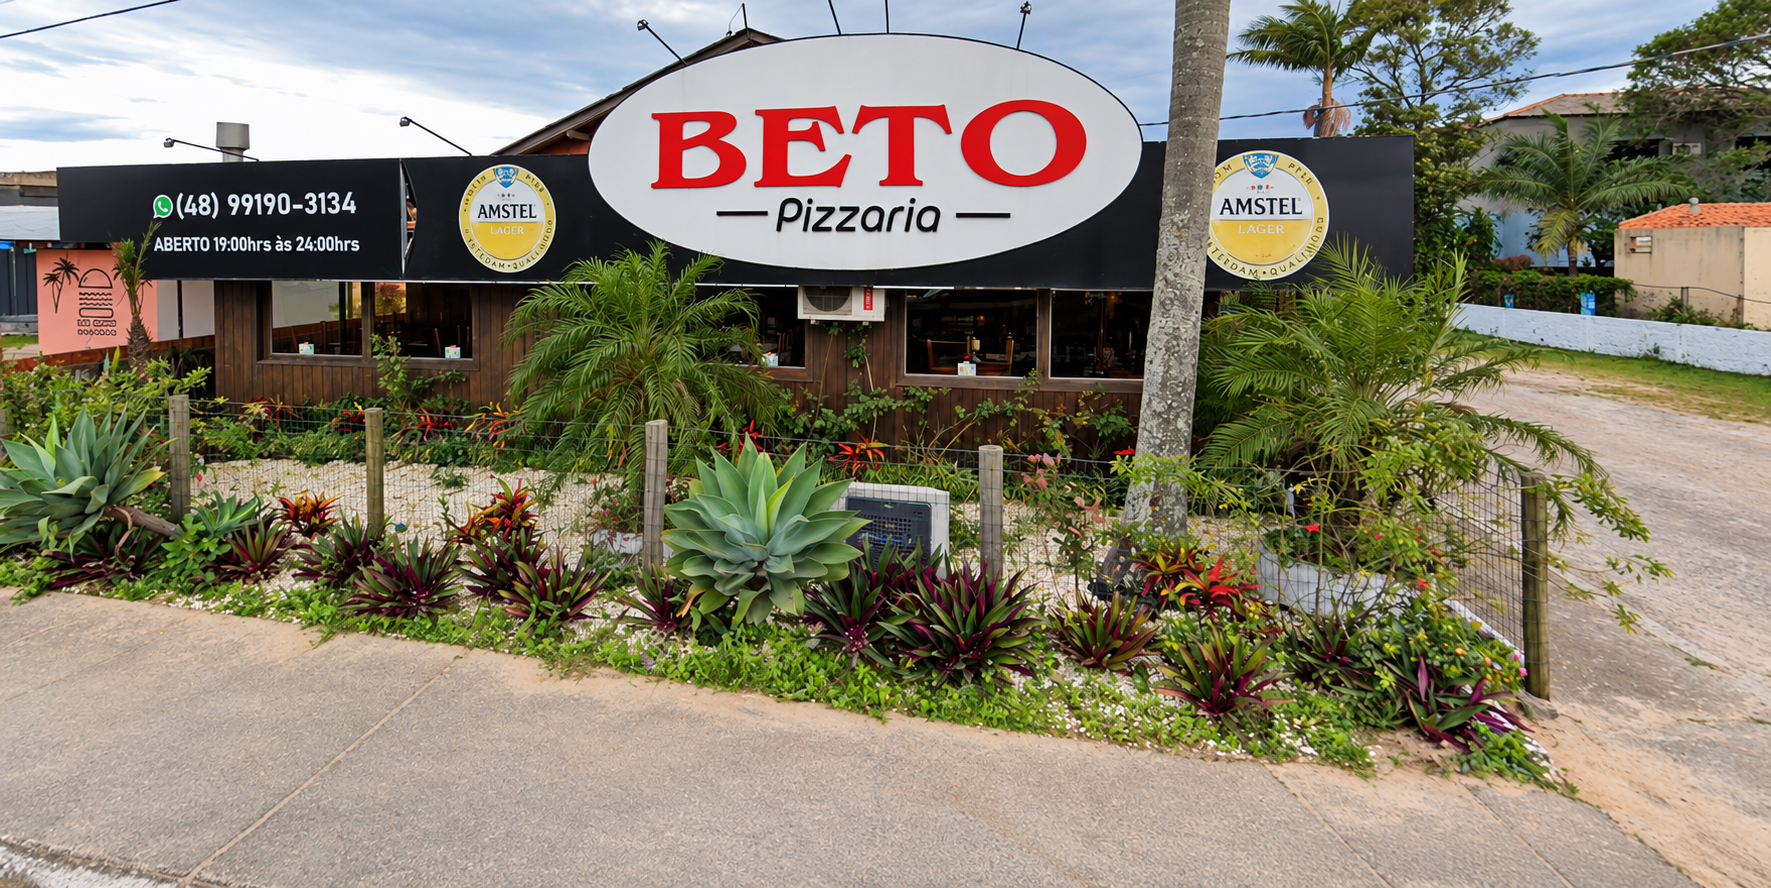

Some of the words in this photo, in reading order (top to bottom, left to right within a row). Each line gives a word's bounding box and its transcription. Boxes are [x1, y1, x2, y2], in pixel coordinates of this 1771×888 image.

[651, 99, 1087, 189] BETO
[176, 192, 219, 220] (48)
[227, 192, 357, 216] 99190-3134
[477, 203, 537, 219] AMSTEL
[776, 197, 941, 232] Pizzaria
[1219, 198, 1303, 215] AMSTEL
[490, 226, 524, 235] LAGER
[1238, 224, 1285, 234] LAGER
[154, 236, 210, 252] ABERTO
[213, 236, 271, 252] 19:00hrs
[275, 235, 292, 251] às
[296, 236, 360, 252] 24:00hrs
